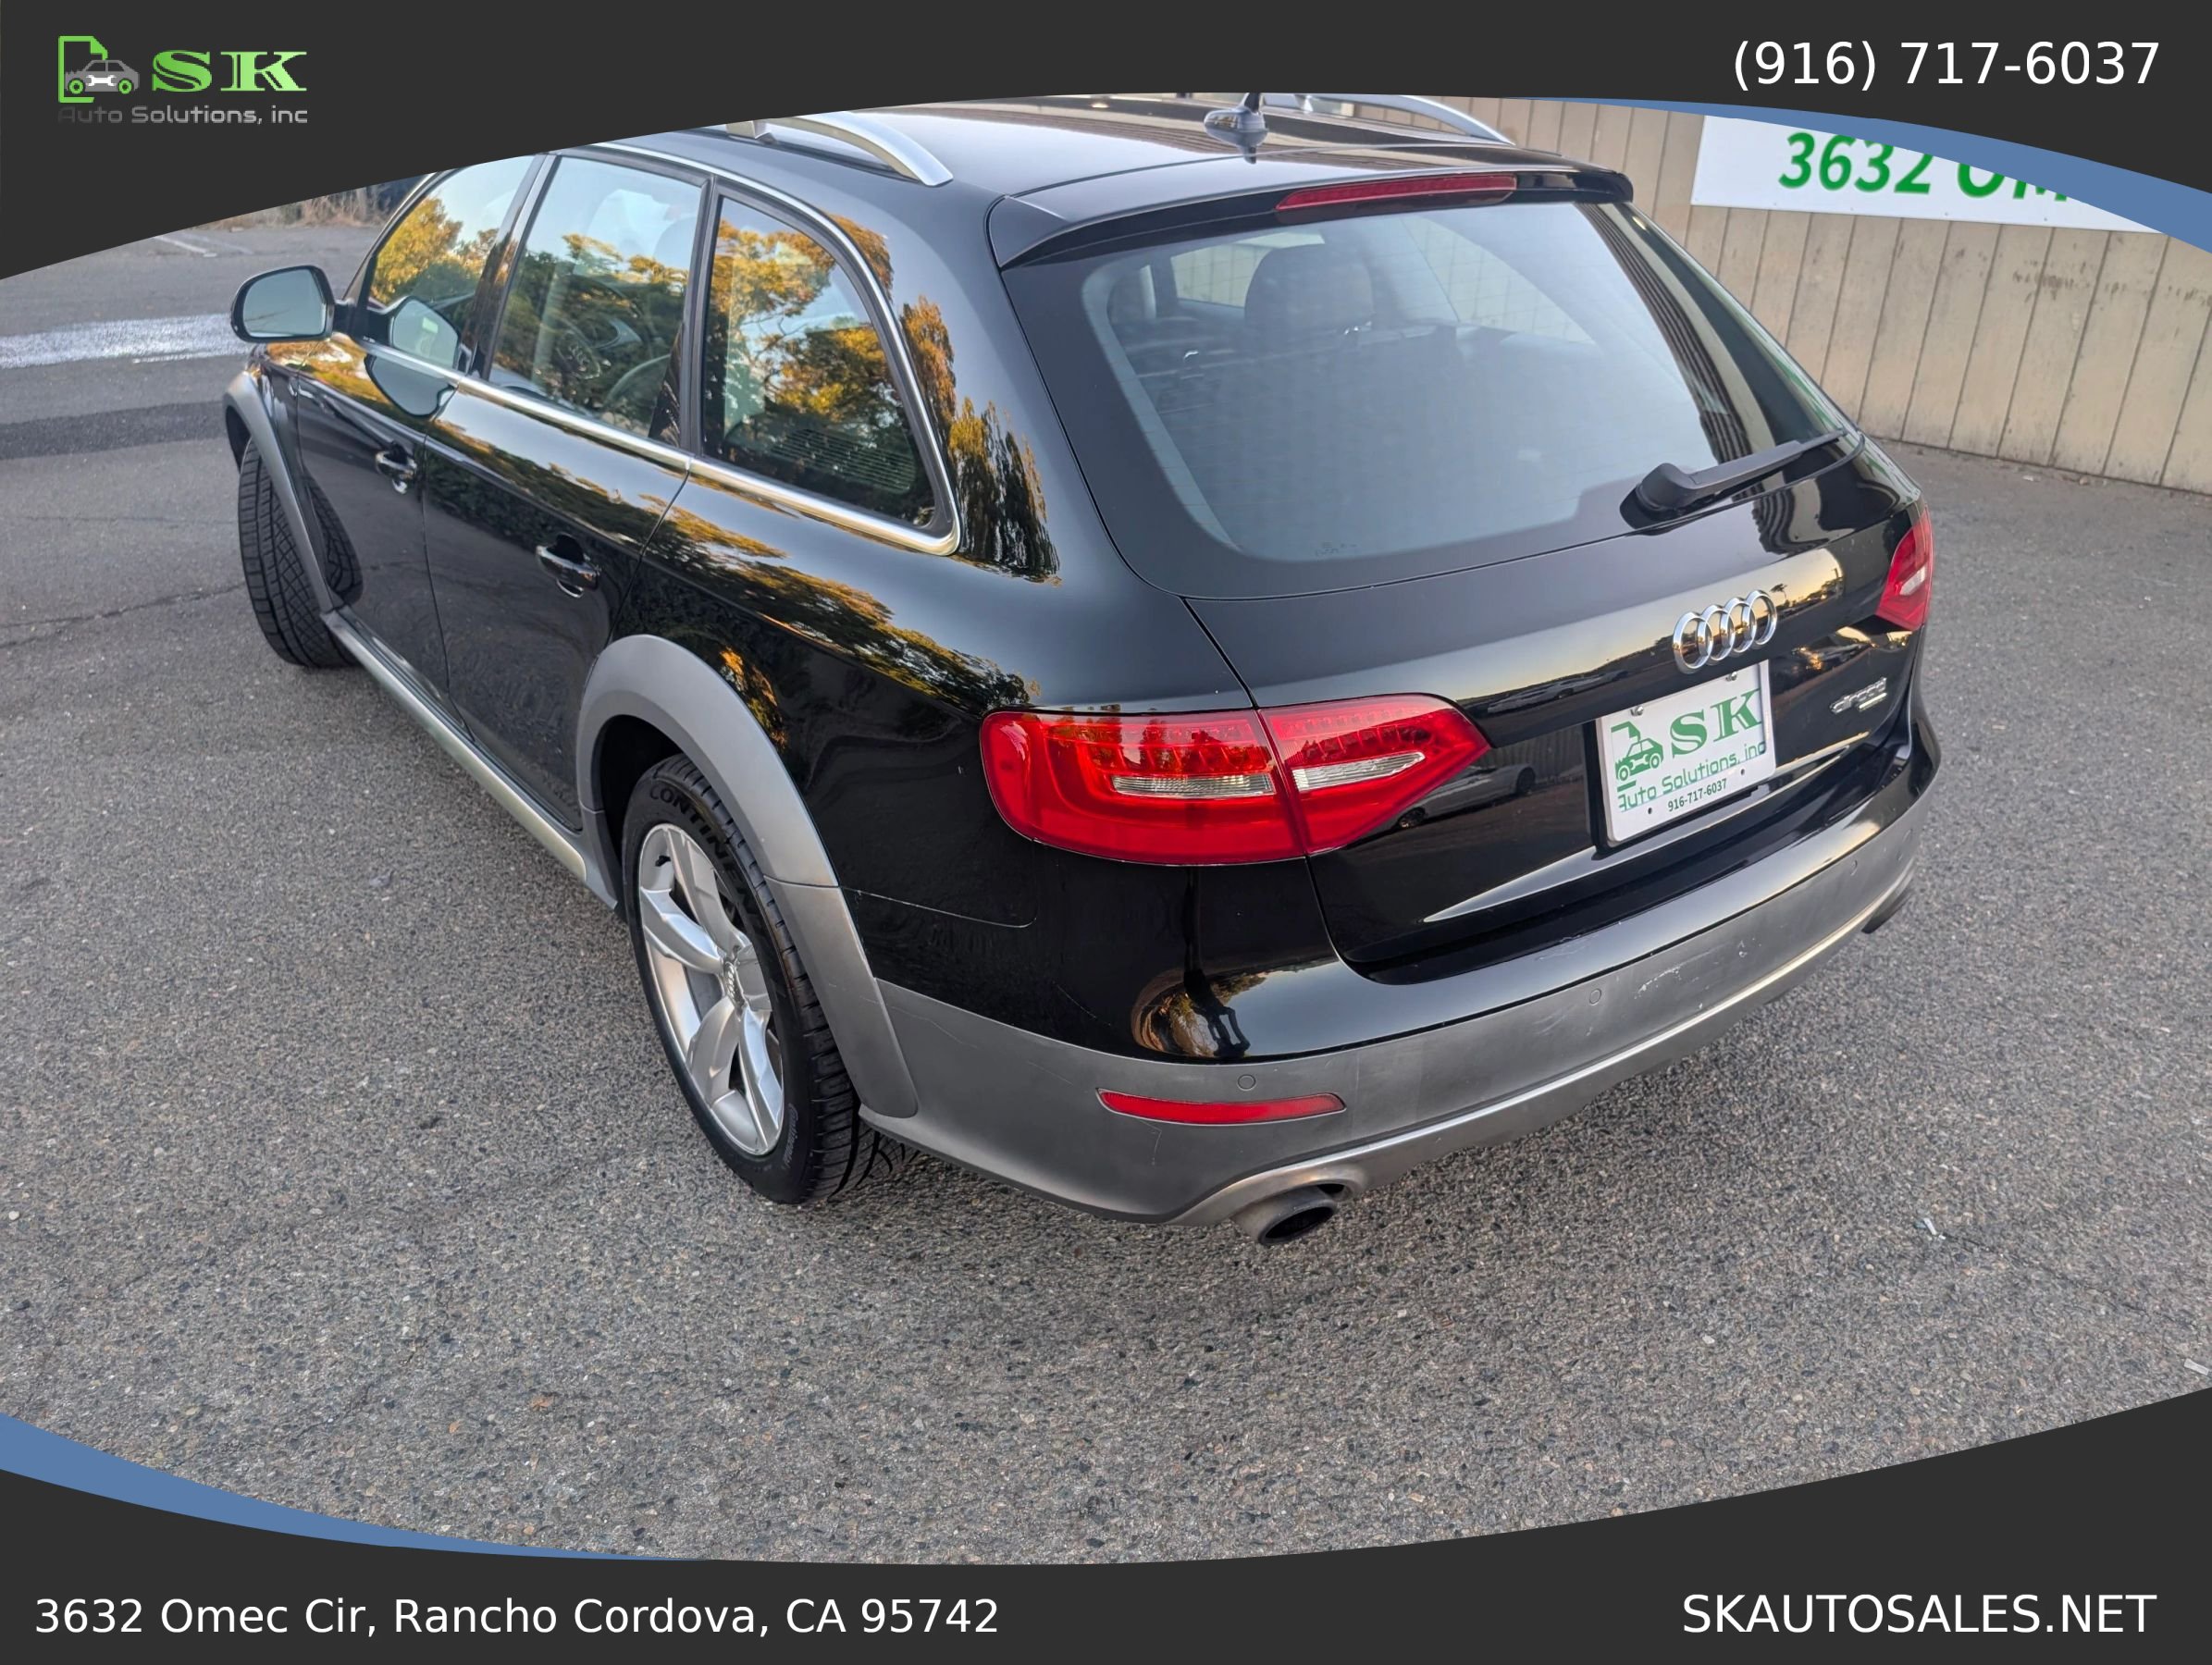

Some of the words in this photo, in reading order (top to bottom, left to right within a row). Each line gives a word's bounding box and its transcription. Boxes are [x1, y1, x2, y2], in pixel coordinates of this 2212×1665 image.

[1778, 131, 1933, 195] 3632
[1669, 687, 1762, 758] SK
[1618, 785, 1658, 813] Auto
[1668, 779, 1728, 812] 916-717-6037
